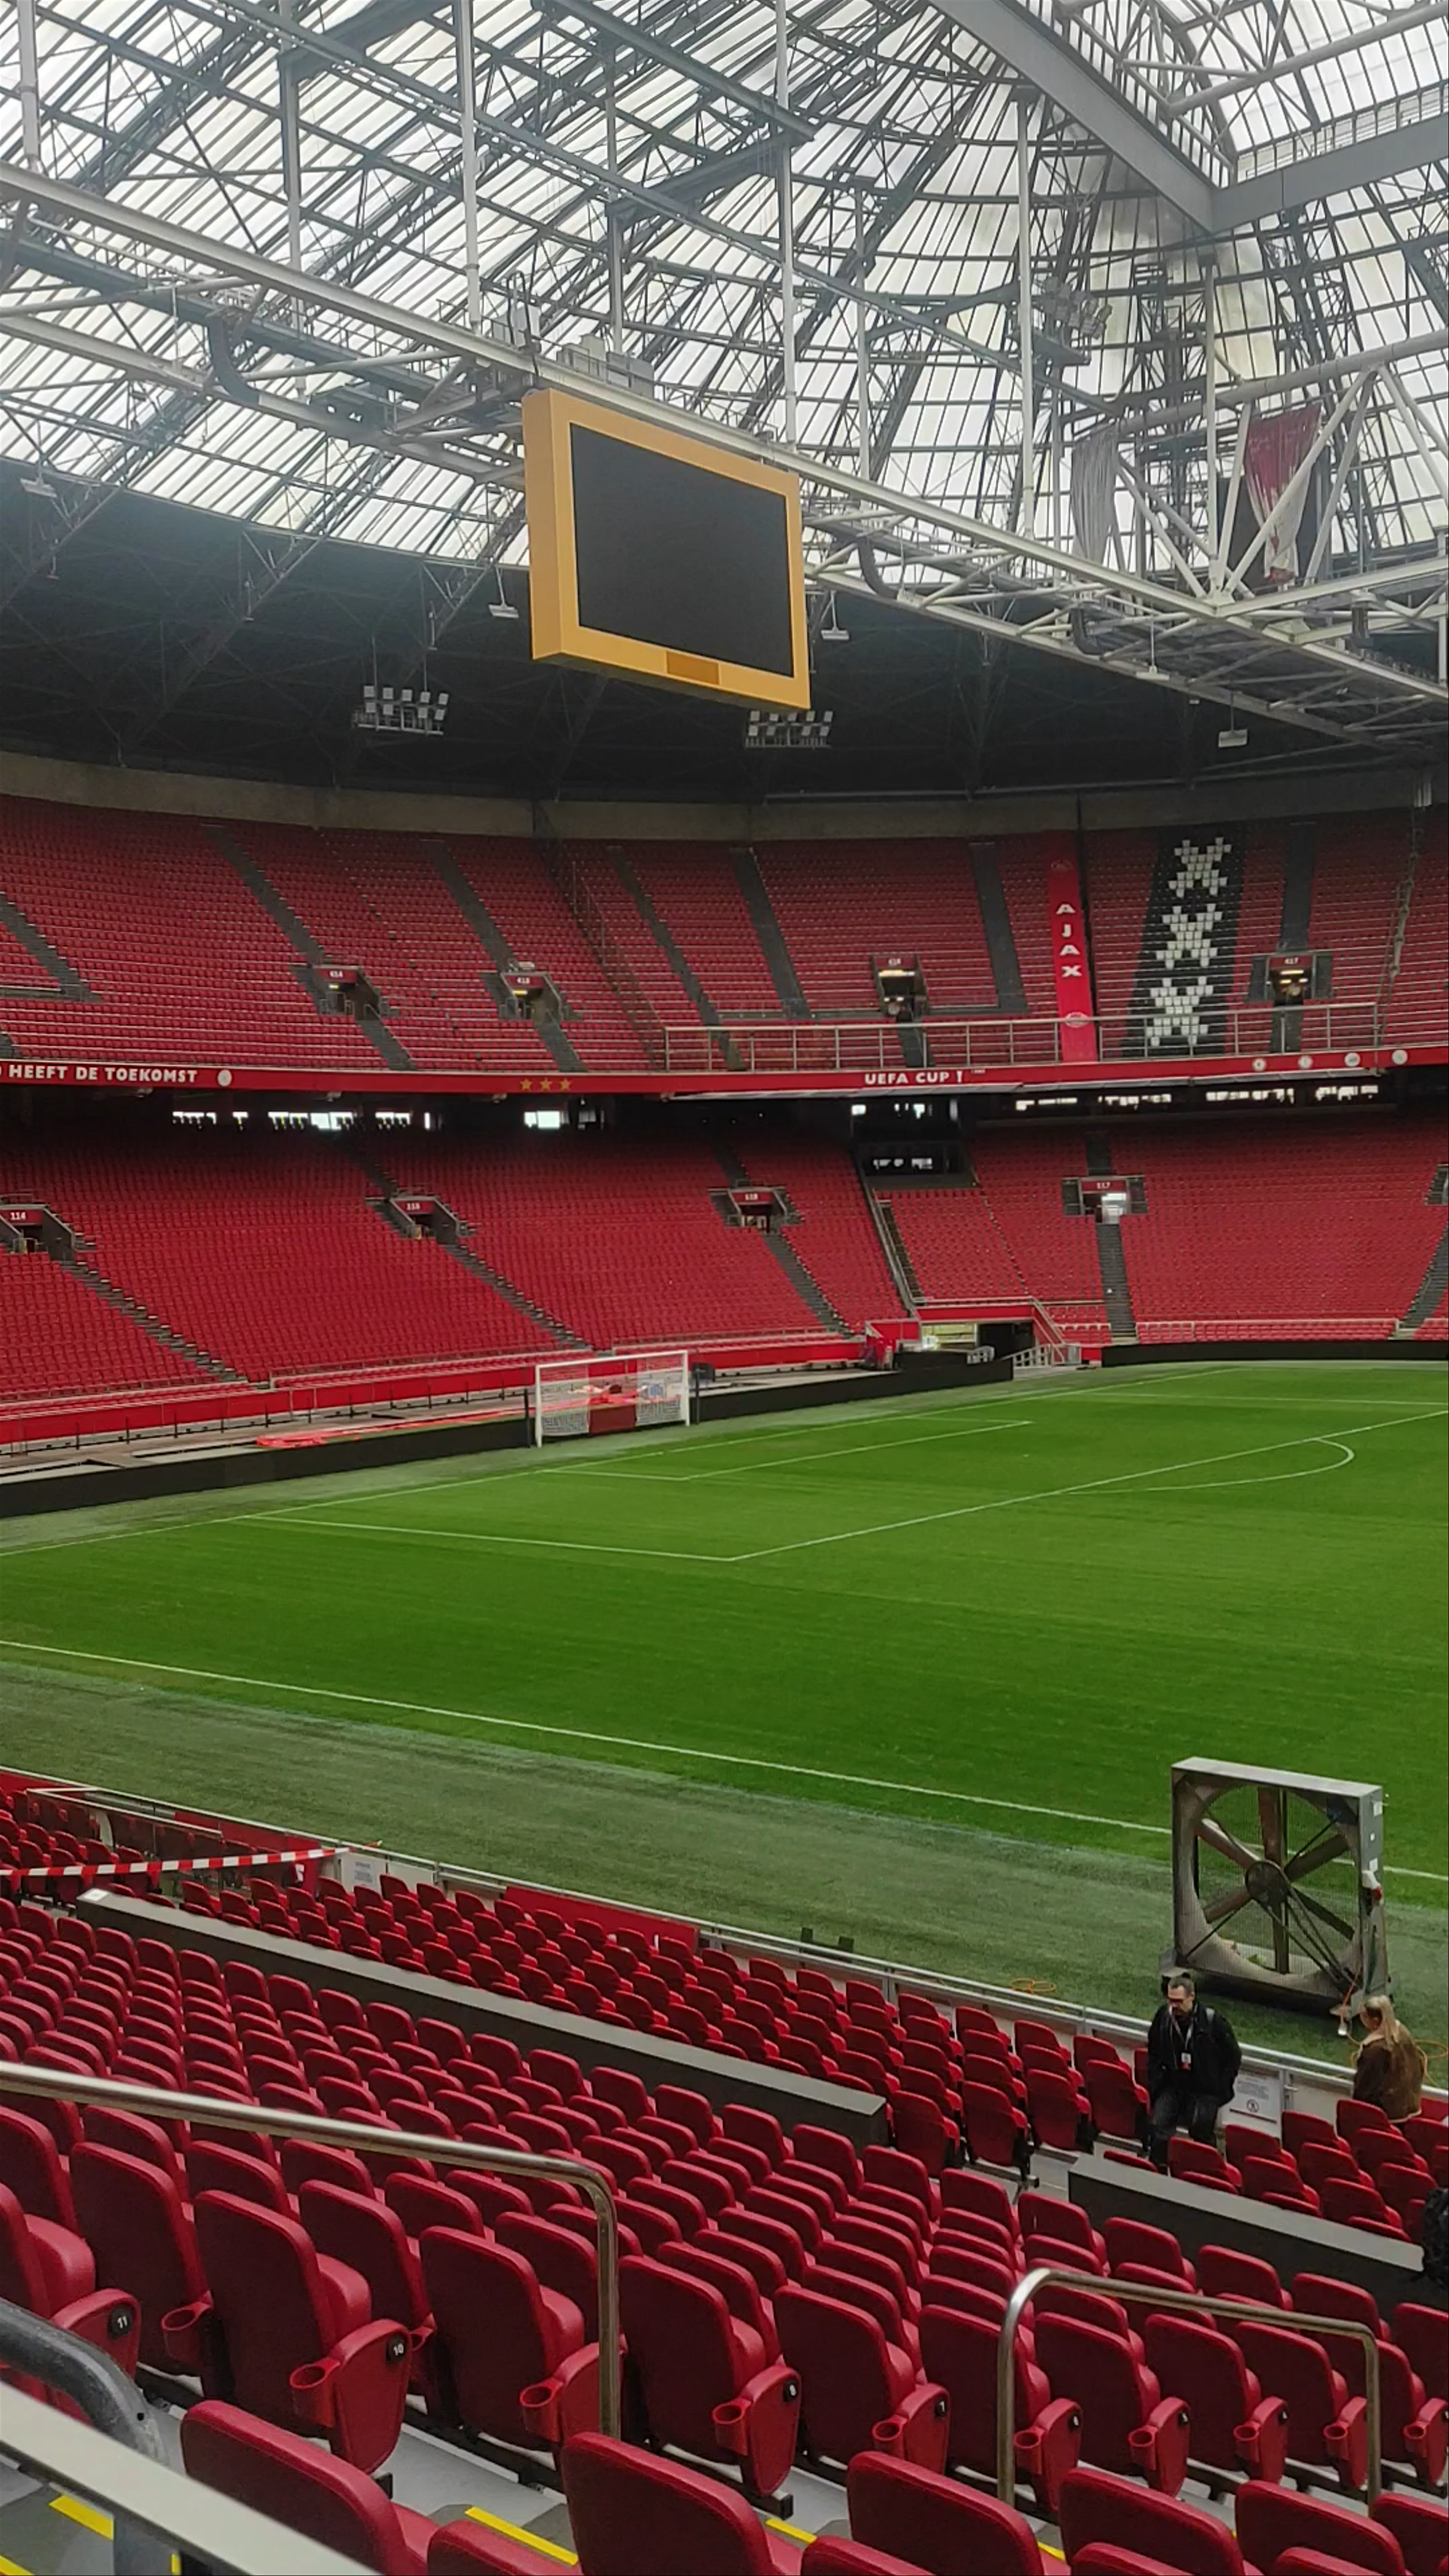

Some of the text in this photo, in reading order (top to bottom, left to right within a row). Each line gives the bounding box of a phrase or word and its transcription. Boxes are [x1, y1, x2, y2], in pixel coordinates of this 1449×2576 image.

[1056, 904, 1082, 978] AJAX
[9, 1064, 68, 1079] HEEFT
[75, 1066, 98, 1080] DE
[105, 1067, 197, 1083] TOEKOMST
[864, 1072, 949, 1084] UEFA CUP
[10, 1211, 26, 1221] 114
[117, 2315, 128, 2329] 11
[393, 2343, 404, 2356] 10
